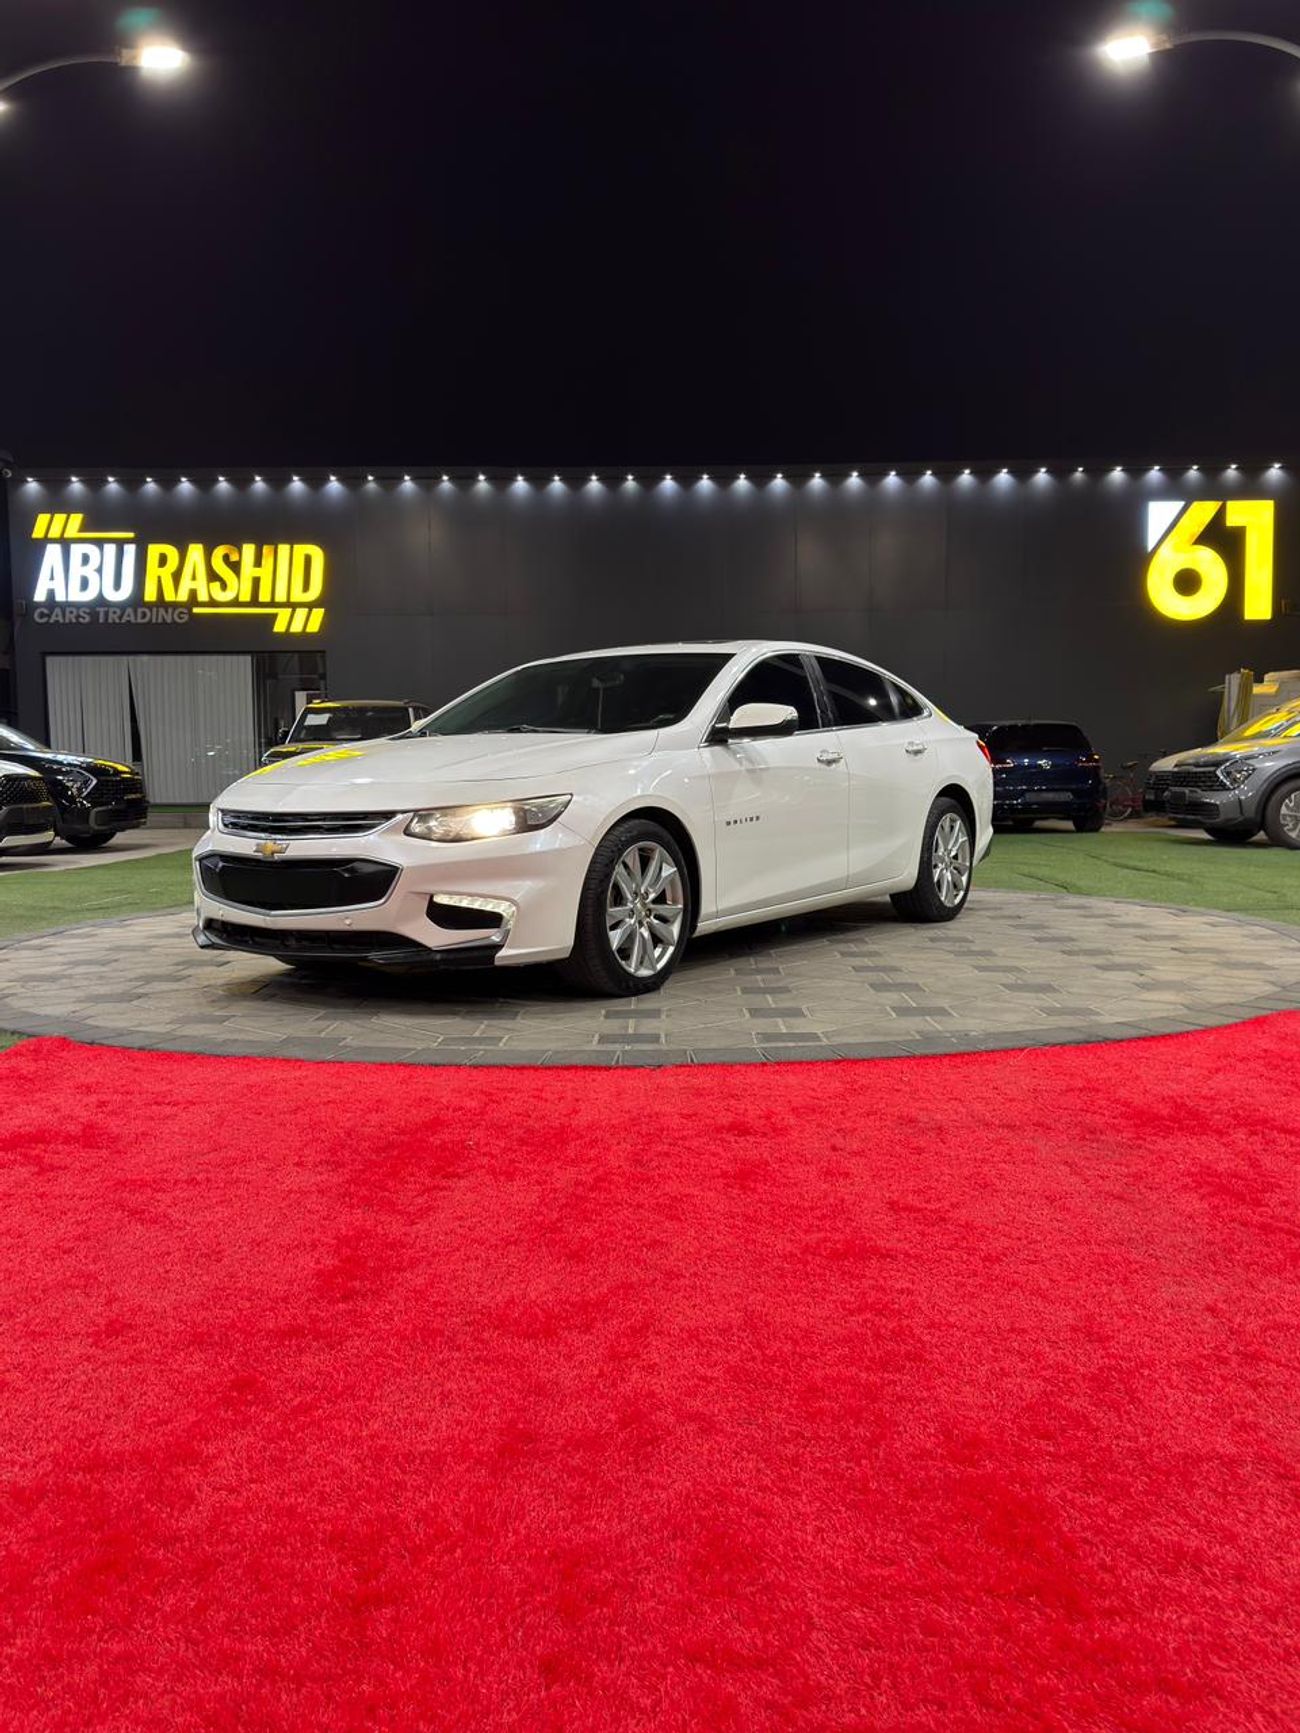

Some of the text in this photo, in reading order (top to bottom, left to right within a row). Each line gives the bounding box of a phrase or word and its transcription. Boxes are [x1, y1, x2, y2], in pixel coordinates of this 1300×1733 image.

[33, 543, 325, 602] ABU RASHID
[1147, 500, 1275, 620] 61
[33, 607, 190, 624] CARS TRADING
